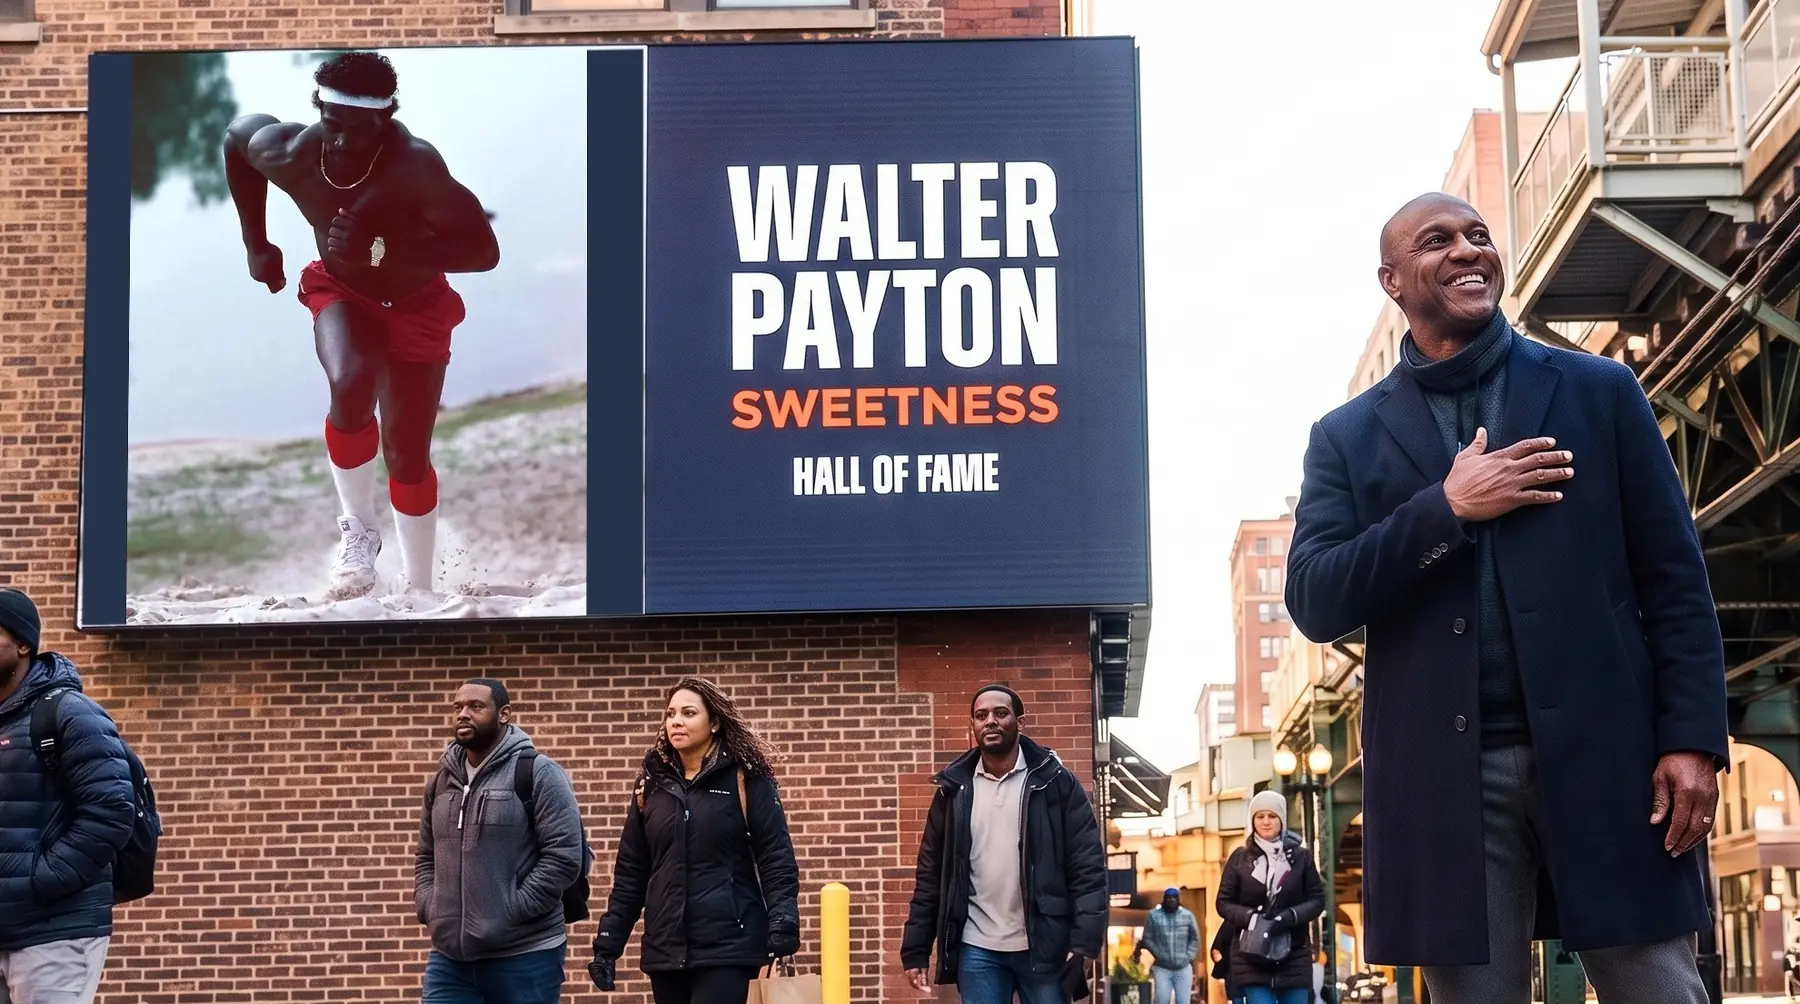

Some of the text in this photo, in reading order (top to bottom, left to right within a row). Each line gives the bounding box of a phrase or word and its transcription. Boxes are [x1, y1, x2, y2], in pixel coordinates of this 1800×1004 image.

[726, 161, 1060, 263] WALTER
[731, 266, 1059, 371] PAYTON
[731, 384, 1060, 430] SWEETNESS
[793, 452, 1000, 496] HALL OF FAME
